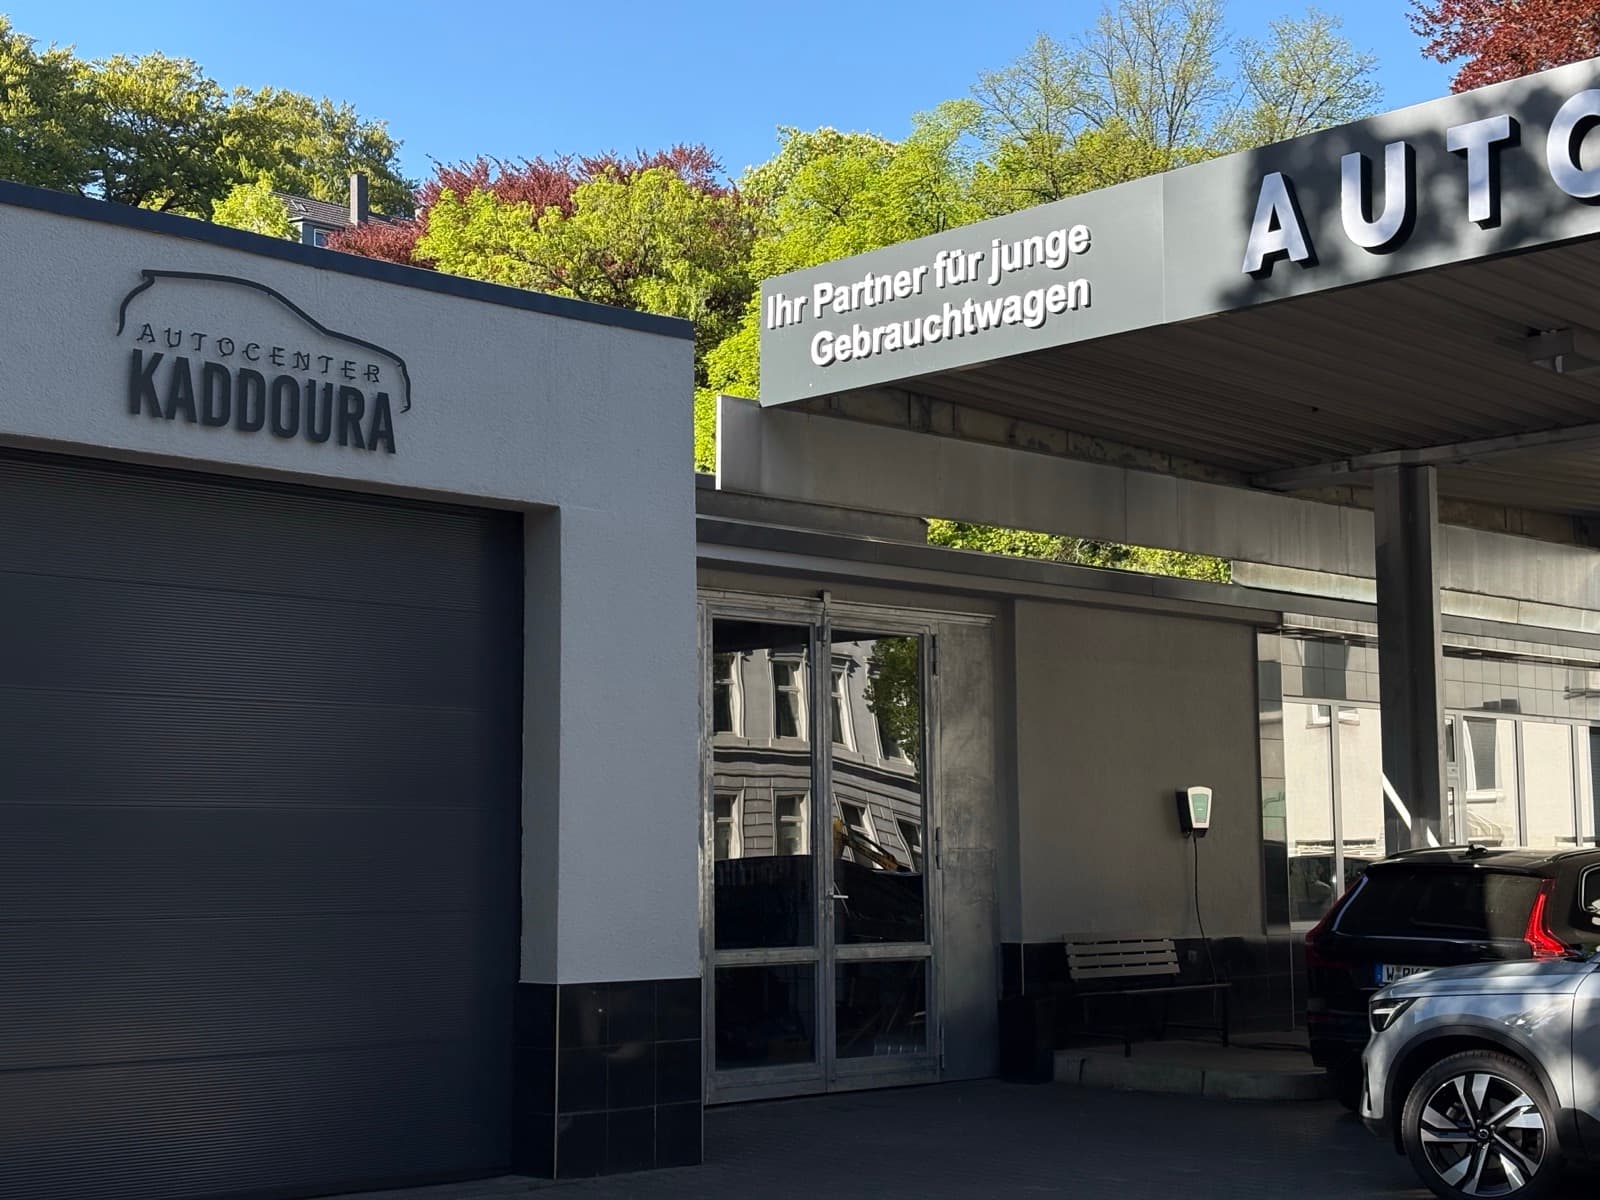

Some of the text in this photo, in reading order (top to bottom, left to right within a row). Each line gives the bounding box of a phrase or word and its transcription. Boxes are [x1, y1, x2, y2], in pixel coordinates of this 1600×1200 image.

[766, 223, 1091, 330] Ihr Partner für junge
[810, 278, 1091, 367] Gebrauchtwagen
[128, 348, 396, 454] KADDOURA
[136, 322, 382, 383] AUTOCENTER
